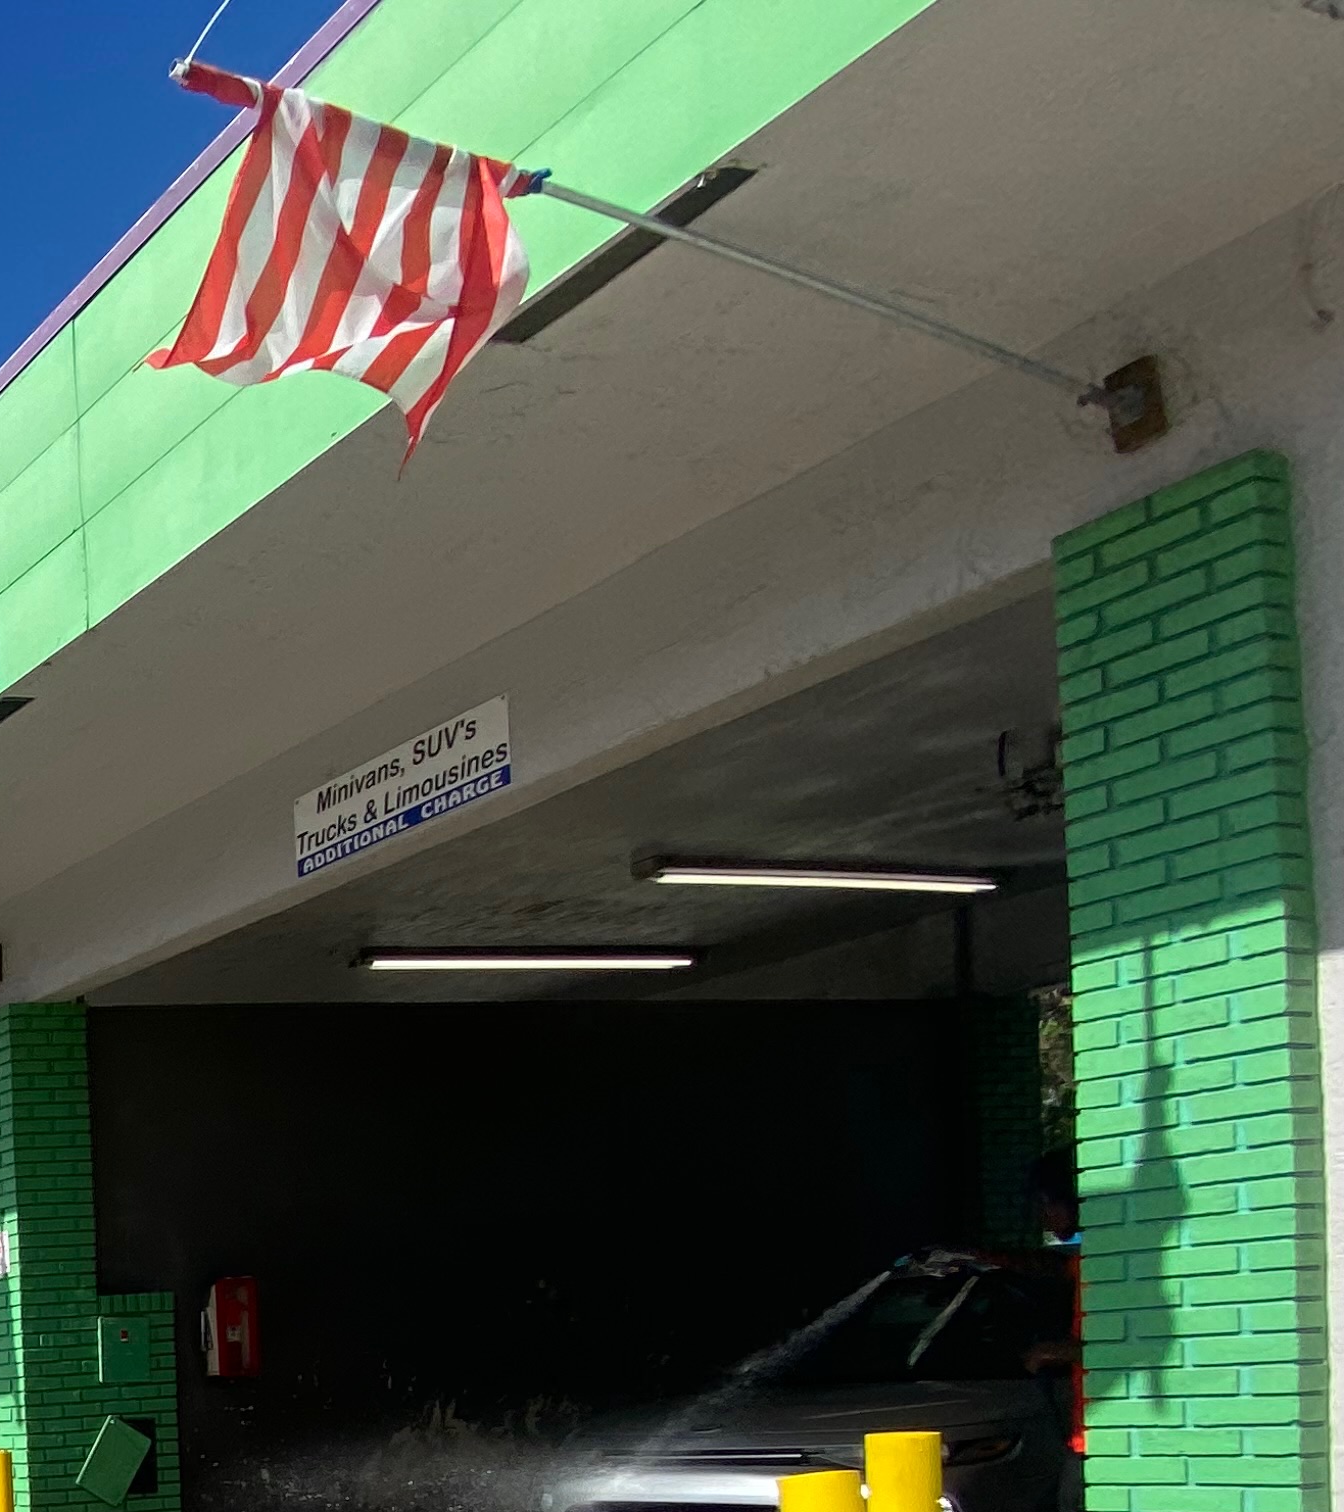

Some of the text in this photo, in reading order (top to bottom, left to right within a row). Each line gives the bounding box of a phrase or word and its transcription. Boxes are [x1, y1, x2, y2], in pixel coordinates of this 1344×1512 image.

[296, 742, 508, 856] Trucks & Limousines
[315, 717, 477, 815] Minivans, SUV's
[302, 769, 504, 874] ADDITIONAL CHARGE
